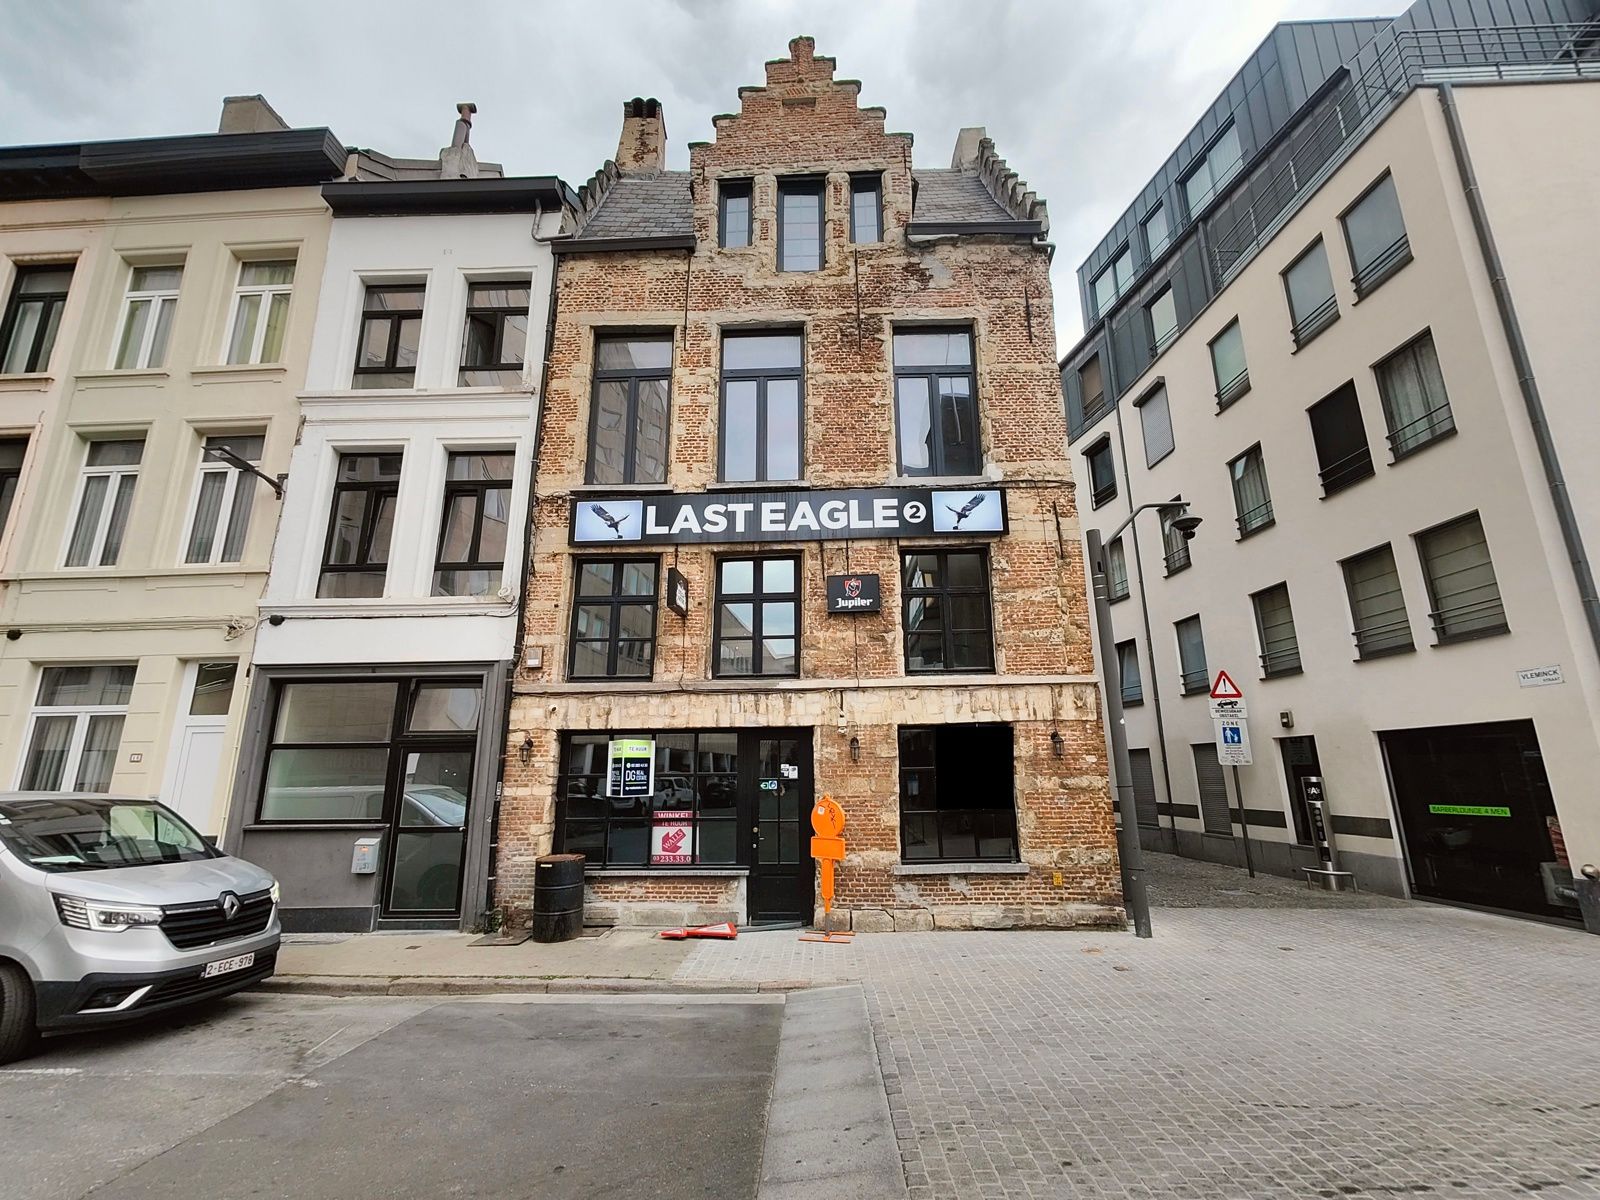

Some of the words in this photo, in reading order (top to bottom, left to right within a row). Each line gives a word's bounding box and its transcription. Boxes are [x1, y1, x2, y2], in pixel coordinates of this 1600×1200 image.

[646, 503, 753, 534] LAST
[761, 498, 899, 531] EAGLE
[835, 597, 873, 608] Jupiler
[1520, 669, 1559, 680] VLEMINCK
[625, 770, 636, 781] DG
[663, 830, 684, 849] WALLS
[206, 954, 253, 975] 2-ECE-978
